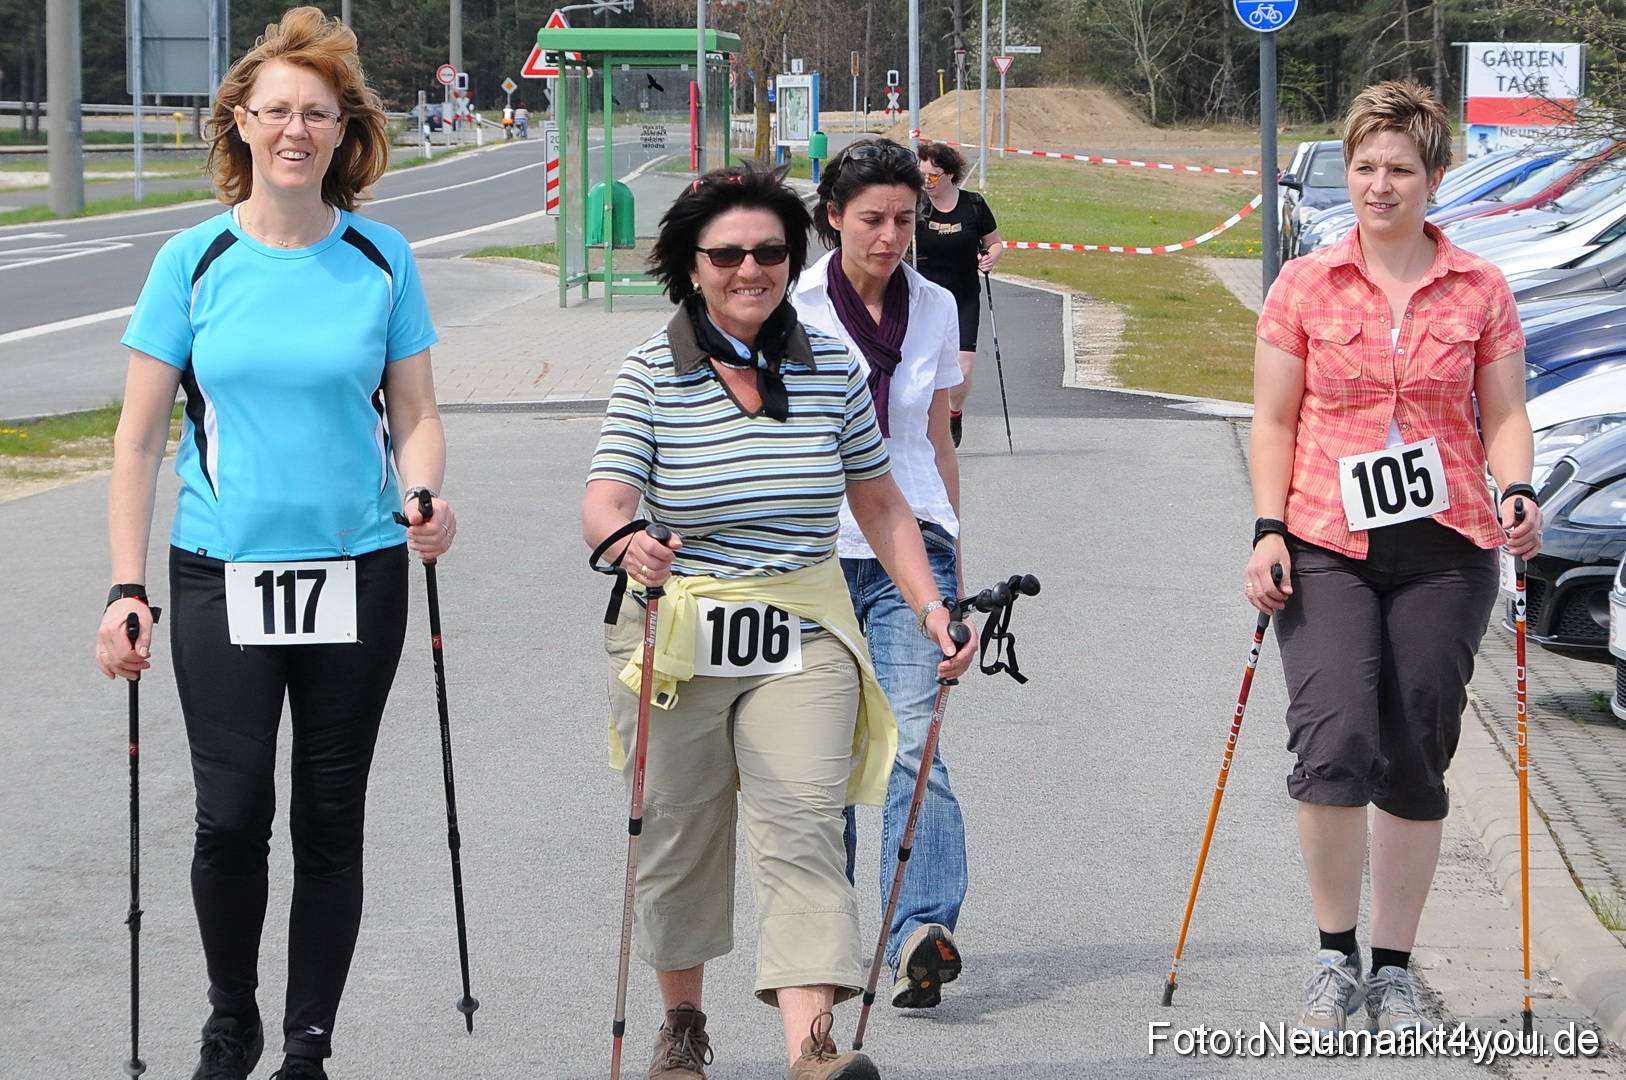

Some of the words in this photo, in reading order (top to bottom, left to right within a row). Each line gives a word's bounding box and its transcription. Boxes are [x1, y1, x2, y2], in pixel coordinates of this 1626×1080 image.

[1483, 50, 1565, 67] GARTEN
[1496, 76, 1549, 93] TAGE
[1351, 447, 1434, 519] 105
[254, 569, 327, 634] 117
[706, 604, 790, 667] 106
